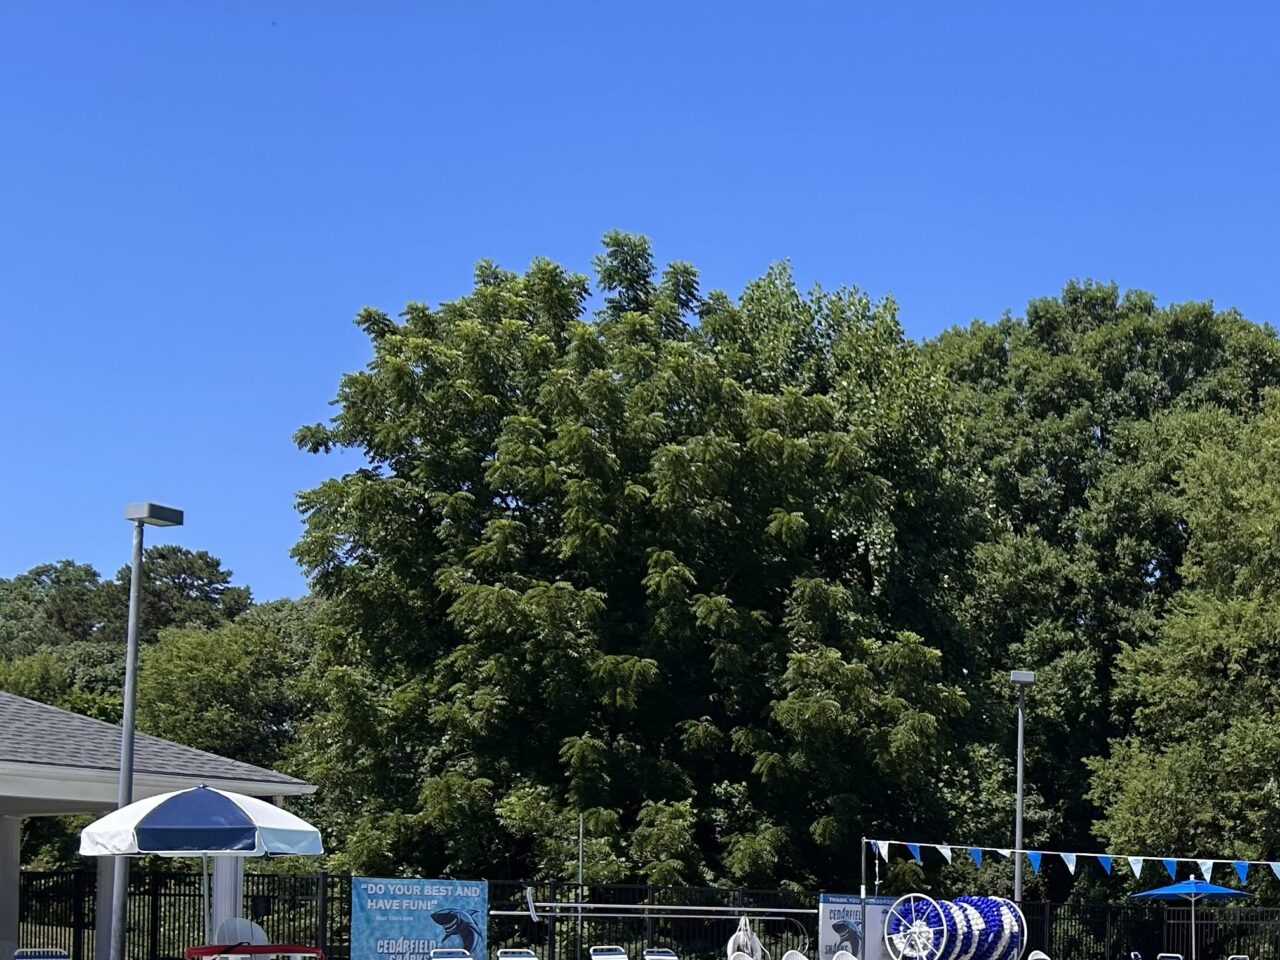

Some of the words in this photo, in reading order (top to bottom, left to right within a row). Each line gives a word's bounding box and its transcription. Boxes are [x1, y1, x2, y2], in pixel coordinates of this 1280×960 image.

[388, 884, 421, 896] YOUR
[424, 885, 454, 897] BEST
[456, 886, 480, 897] AND
[367, 899, 400, 910] HAVE
[829, 906, 862, 921] CEDARFIEL
